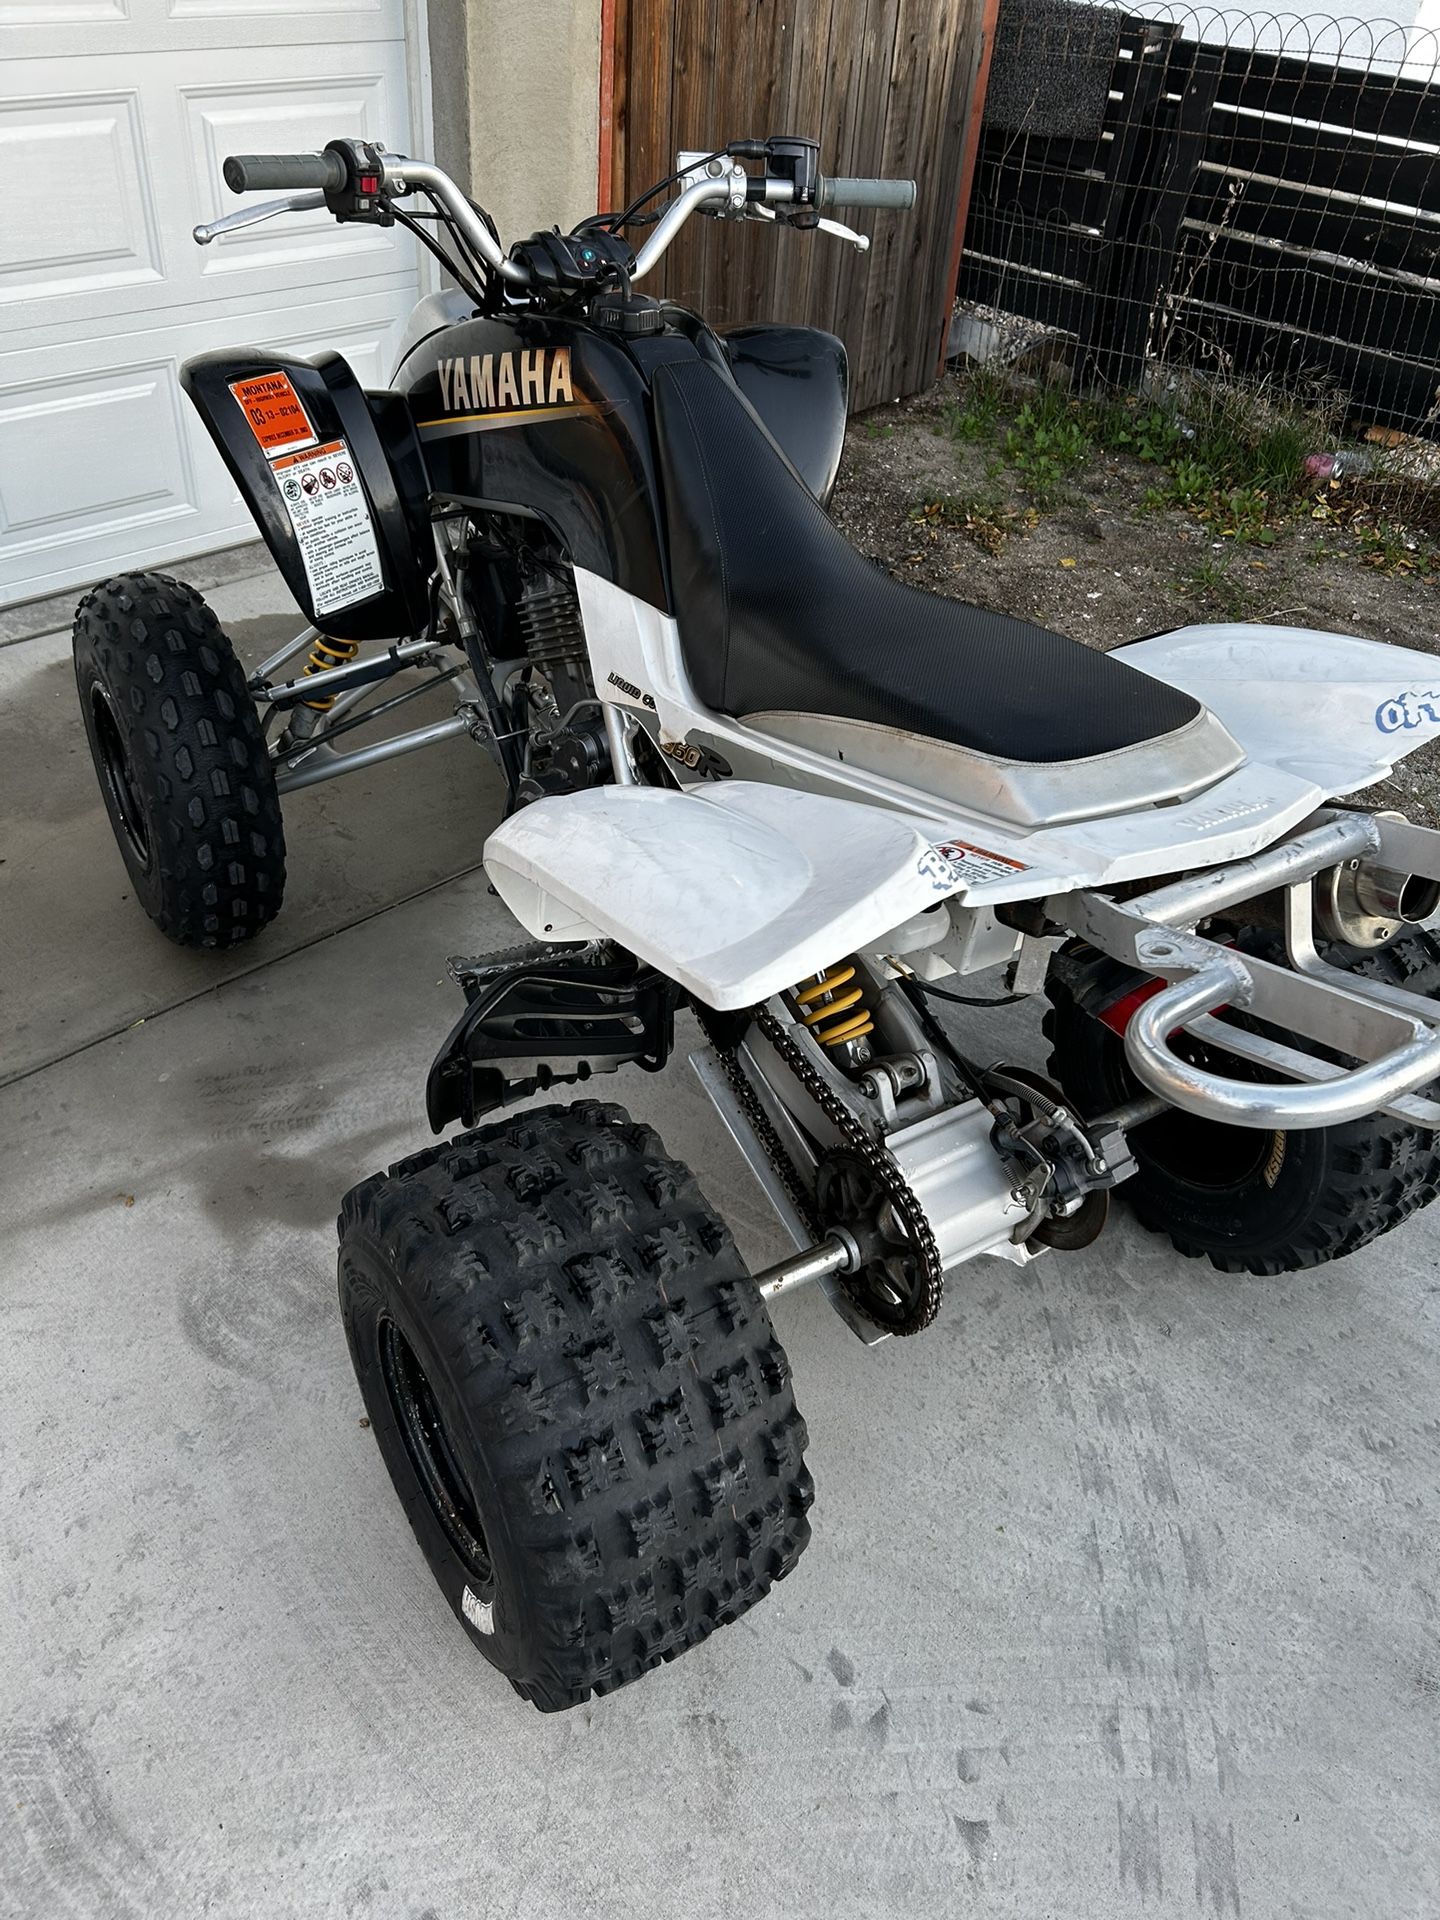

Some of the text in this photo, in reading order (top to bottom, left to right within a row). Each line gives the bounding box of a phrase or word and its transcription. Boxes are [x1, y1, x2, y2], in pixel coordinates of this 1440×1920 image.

[241, 380, 283, 396] MONTANA
[437, 348, 574, 411] YAMAHA
[250, 408, 266, 426] 03
[298, 447, 326, 461] WARNING
[607, 672, 641, 699] LIQUID
